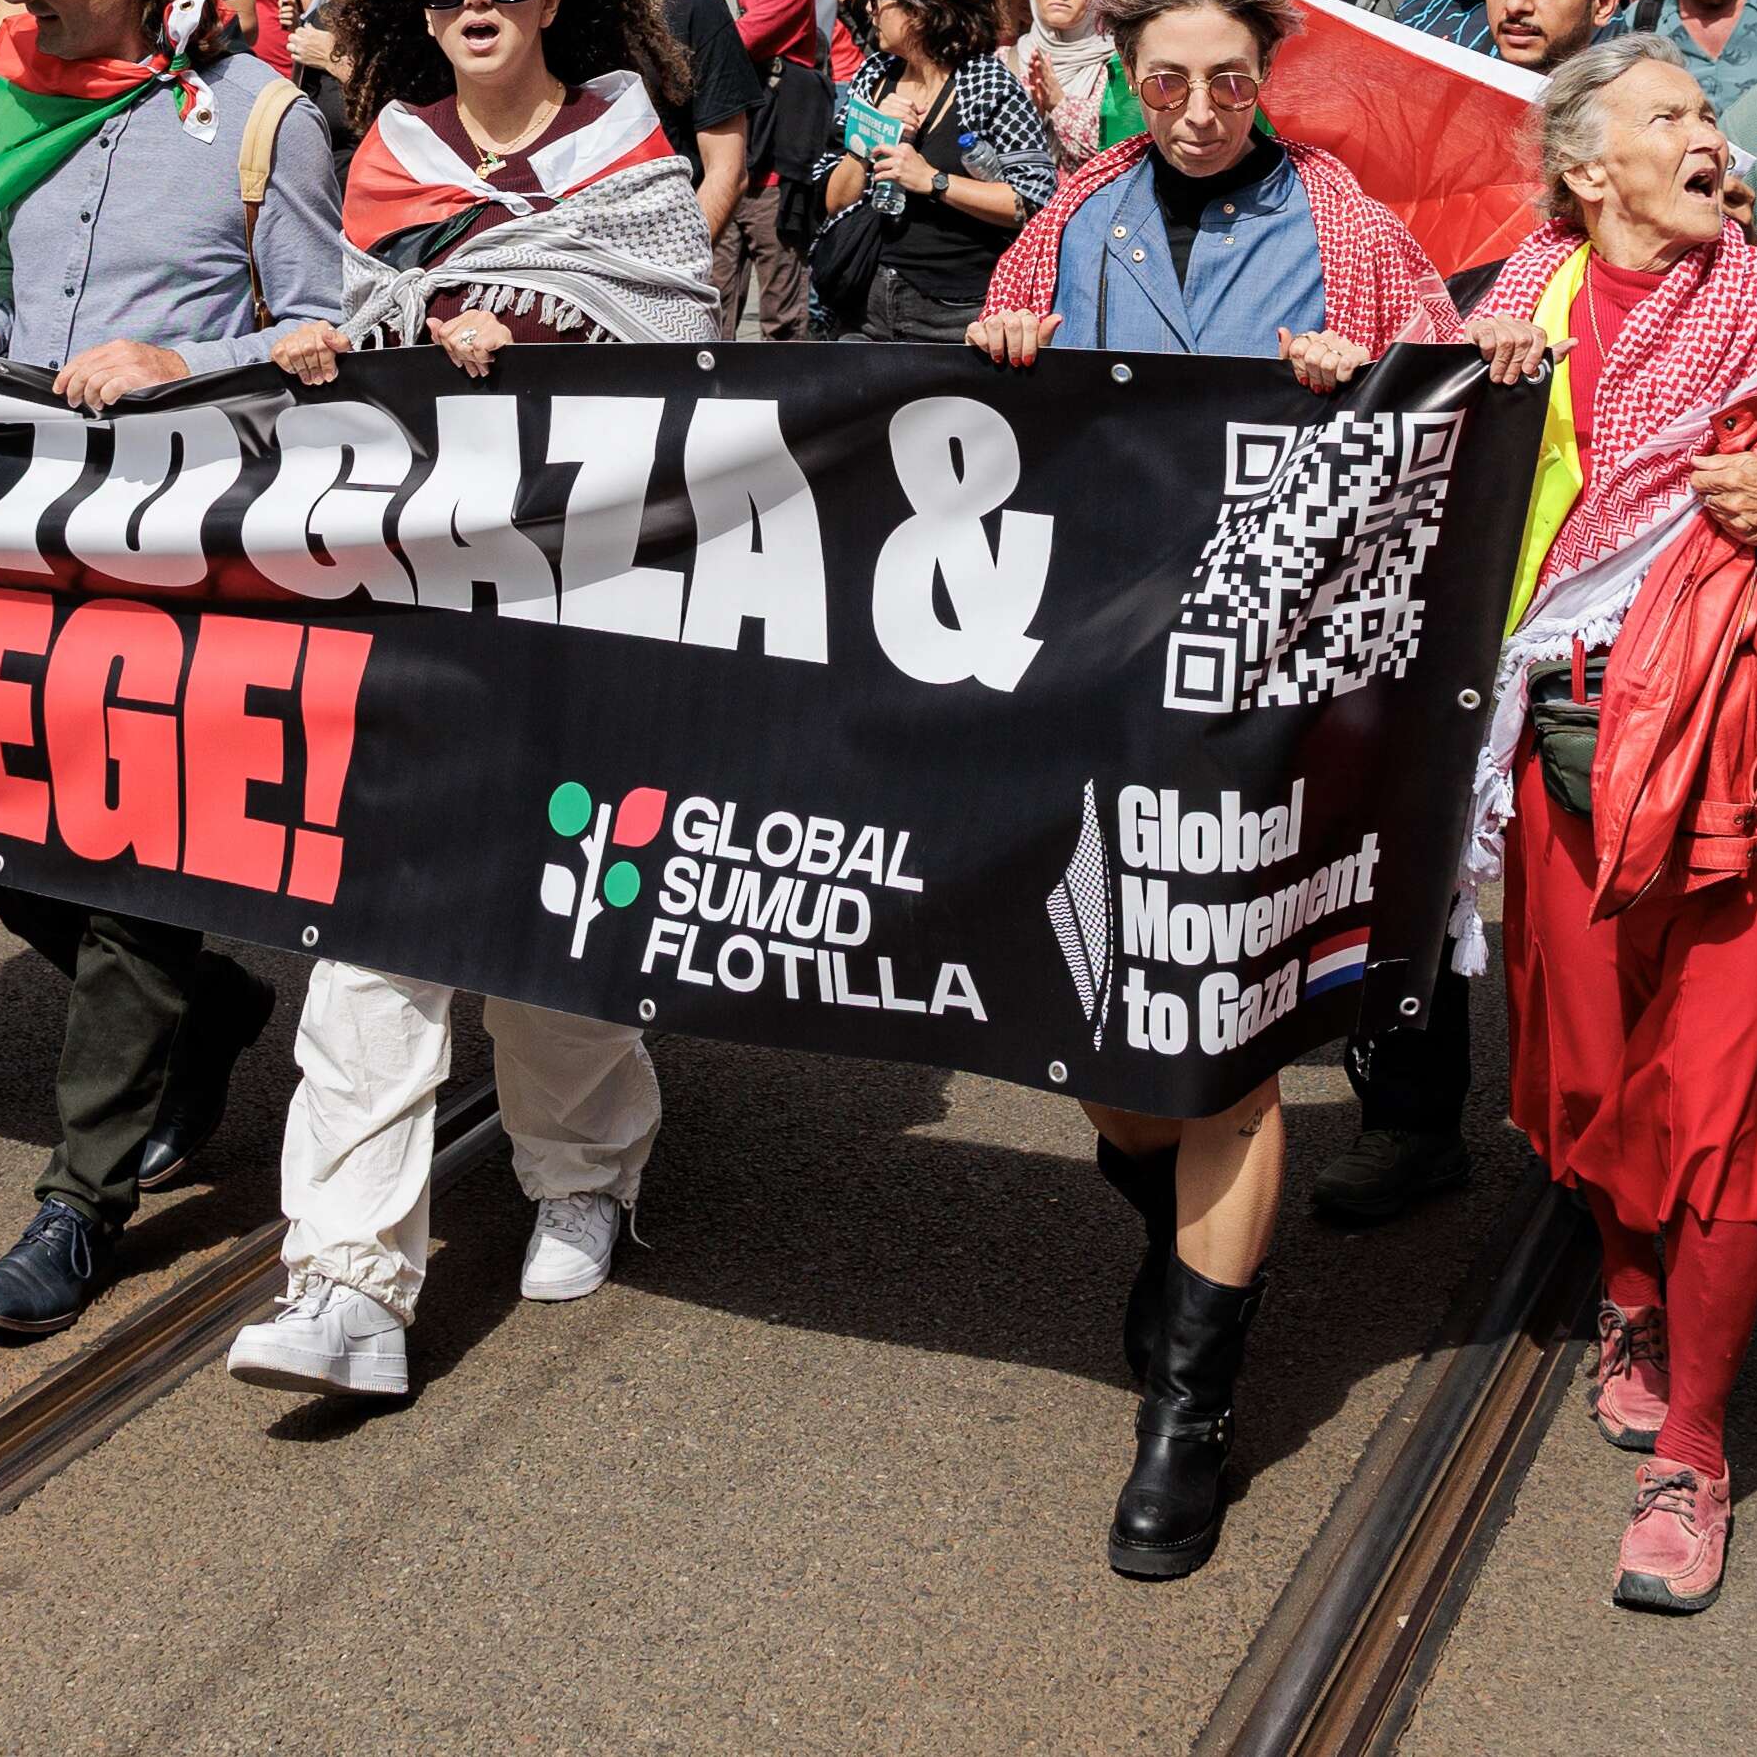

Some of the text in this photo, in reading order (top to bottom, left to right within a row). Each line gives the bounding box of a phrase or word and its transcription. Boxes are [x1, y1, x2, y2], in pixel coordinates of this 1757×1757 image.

[242, 394, 829, 664] GAZA
[872, 396, 1054, 693] &
[672, 796, 925, 893] GLOBAL
[1118, 777, 1305, 874] Global
[658, 857, 872, 948] SUMUD
[1120, 832, 1380, 965] Movement
[641, 916, 989, 1022] FLOTILLA
[1122, 958, 1301, 1056] to Gaza
